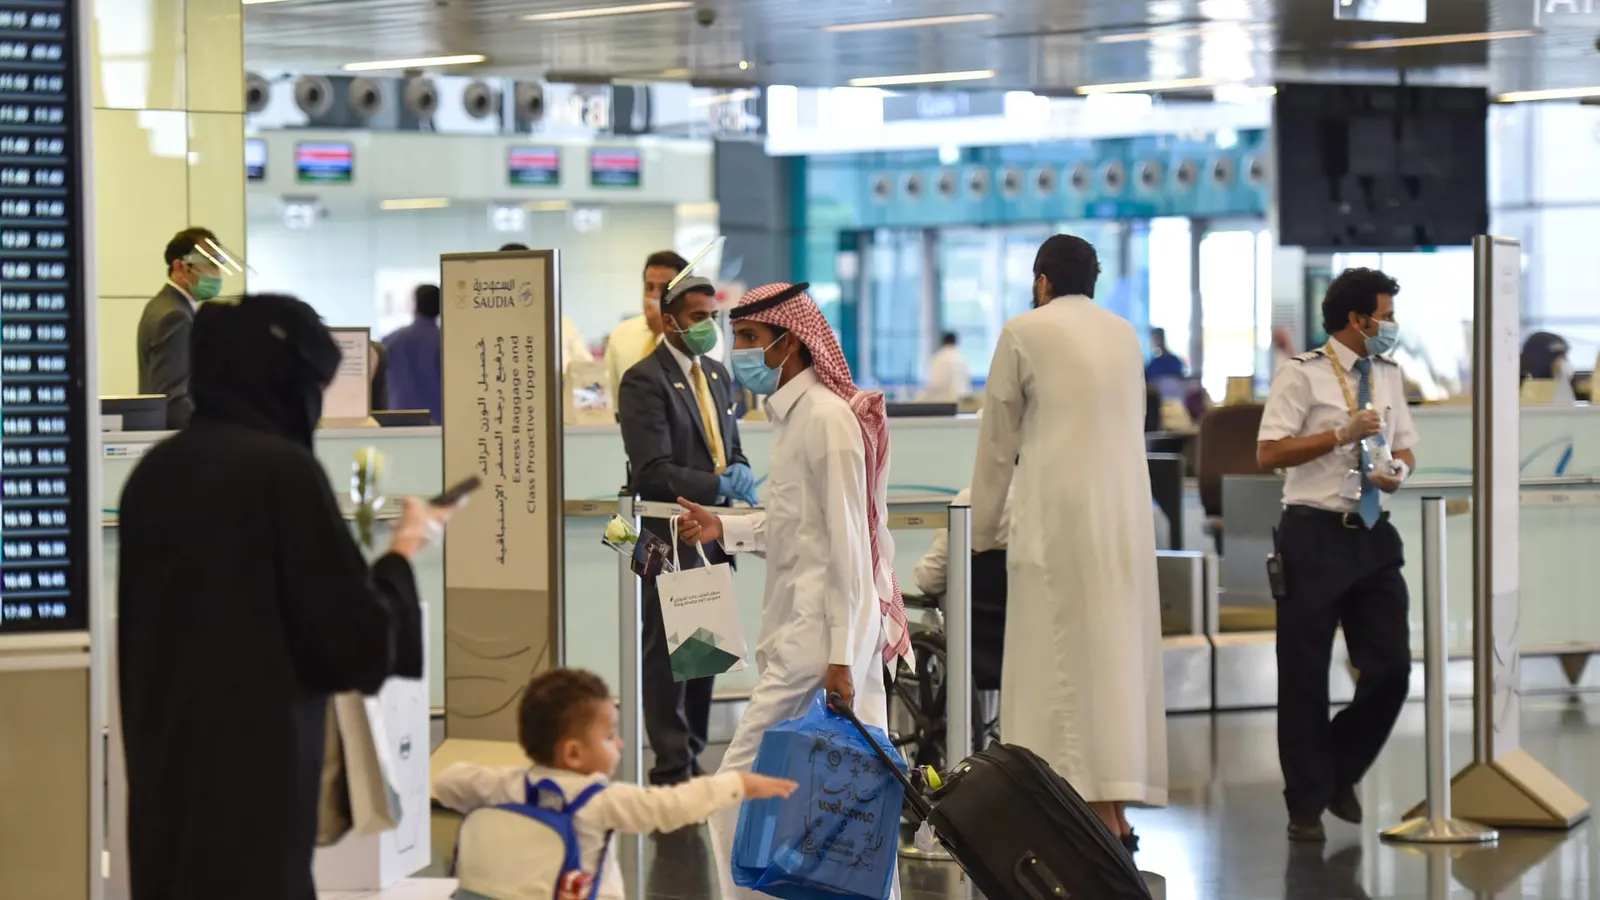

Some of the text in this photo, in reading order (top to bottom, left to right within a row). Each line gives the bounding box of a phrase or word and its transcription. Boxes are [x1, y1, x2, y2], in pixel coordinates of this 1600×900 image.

[473, 296, 515, 308] SAUDIA
[477, 397, 490, 433] الوزن
[510, 335, 522, 483] Excess Baggage and
[524, 335, 536, 514] Class Proactive Upgrade
[494, 431, 507, 480] السفر
[818, 800, 875, 823] welcome
